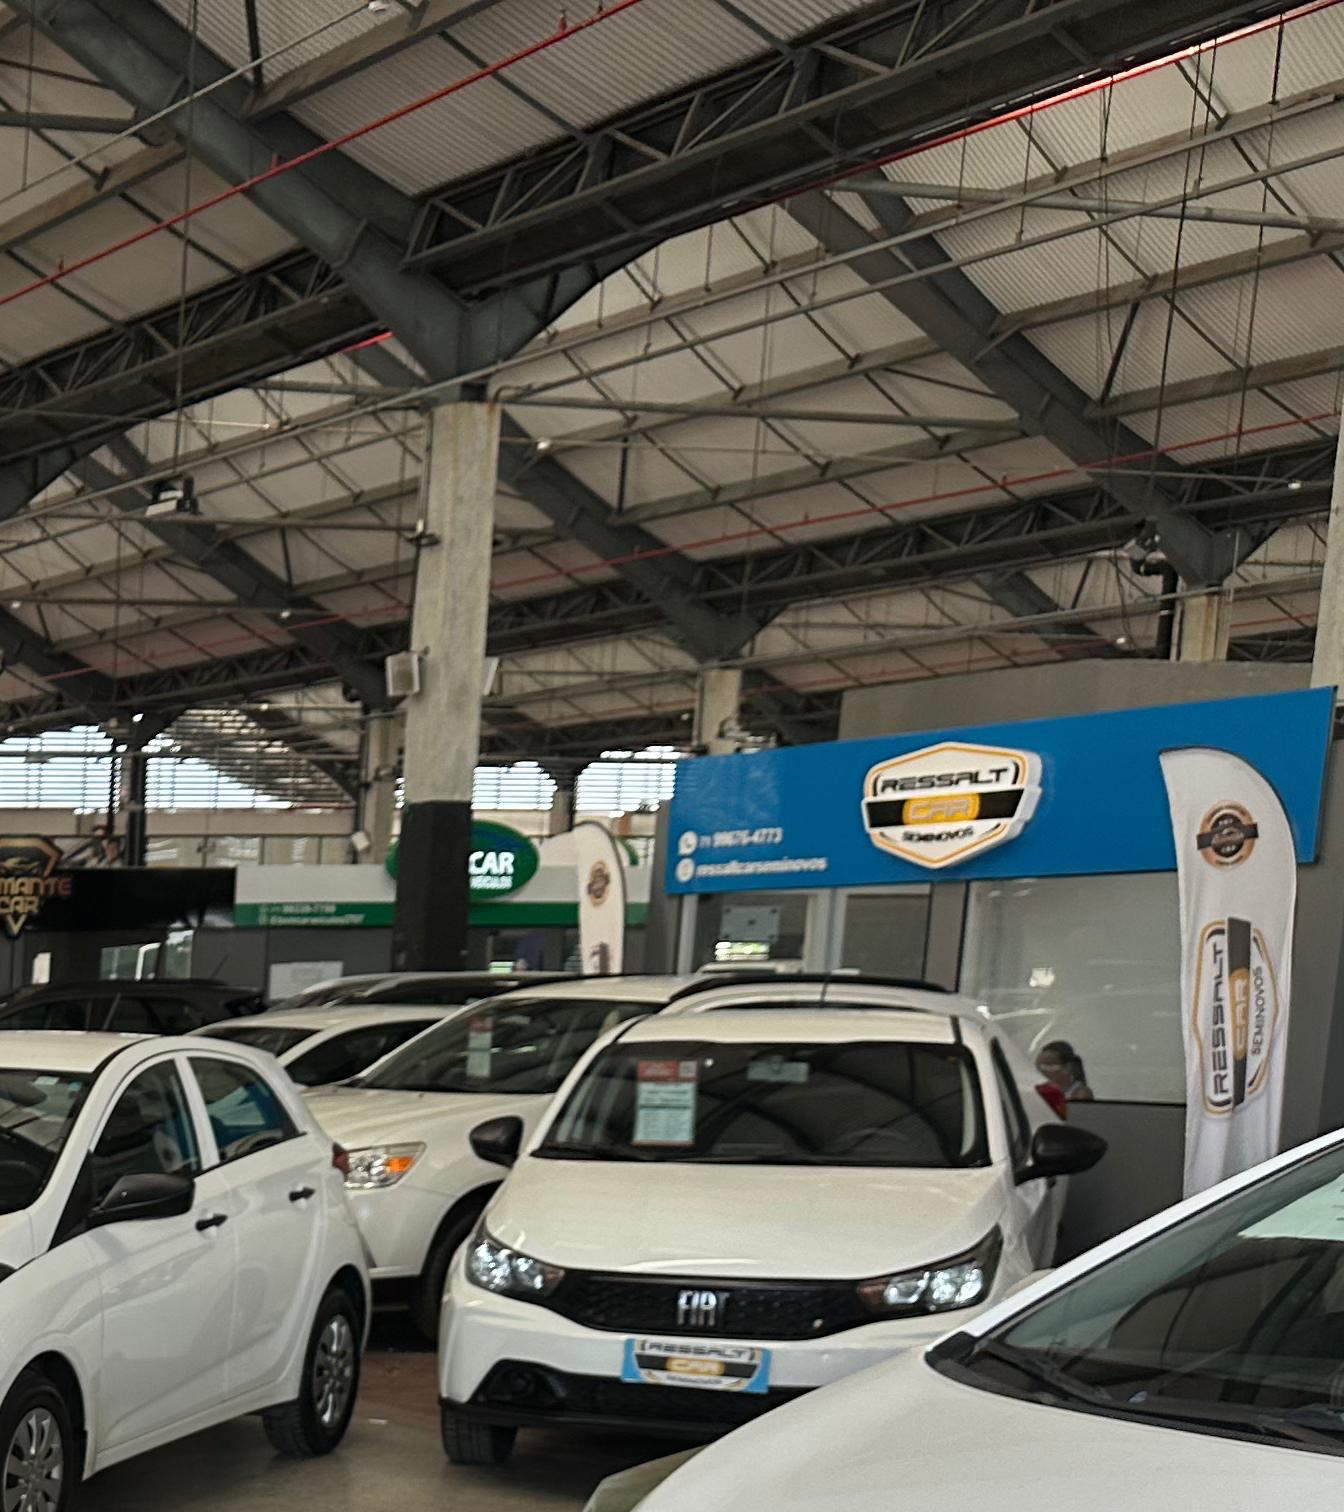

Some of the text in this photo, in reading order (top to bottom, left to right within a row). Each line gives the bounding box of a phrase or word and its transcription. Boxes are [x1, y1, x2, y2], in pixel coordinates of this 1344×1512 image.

[881, 767, 1009, 793] RESSALT
[911, 799, 969, 820] CAR
[468, 850, 515, 876] CAR
[1212, 939, 1229, 1095] RESSALT
[1233, 976, 1249, 1052] CAR
[677, 1289, 730, 1327] FIAT
